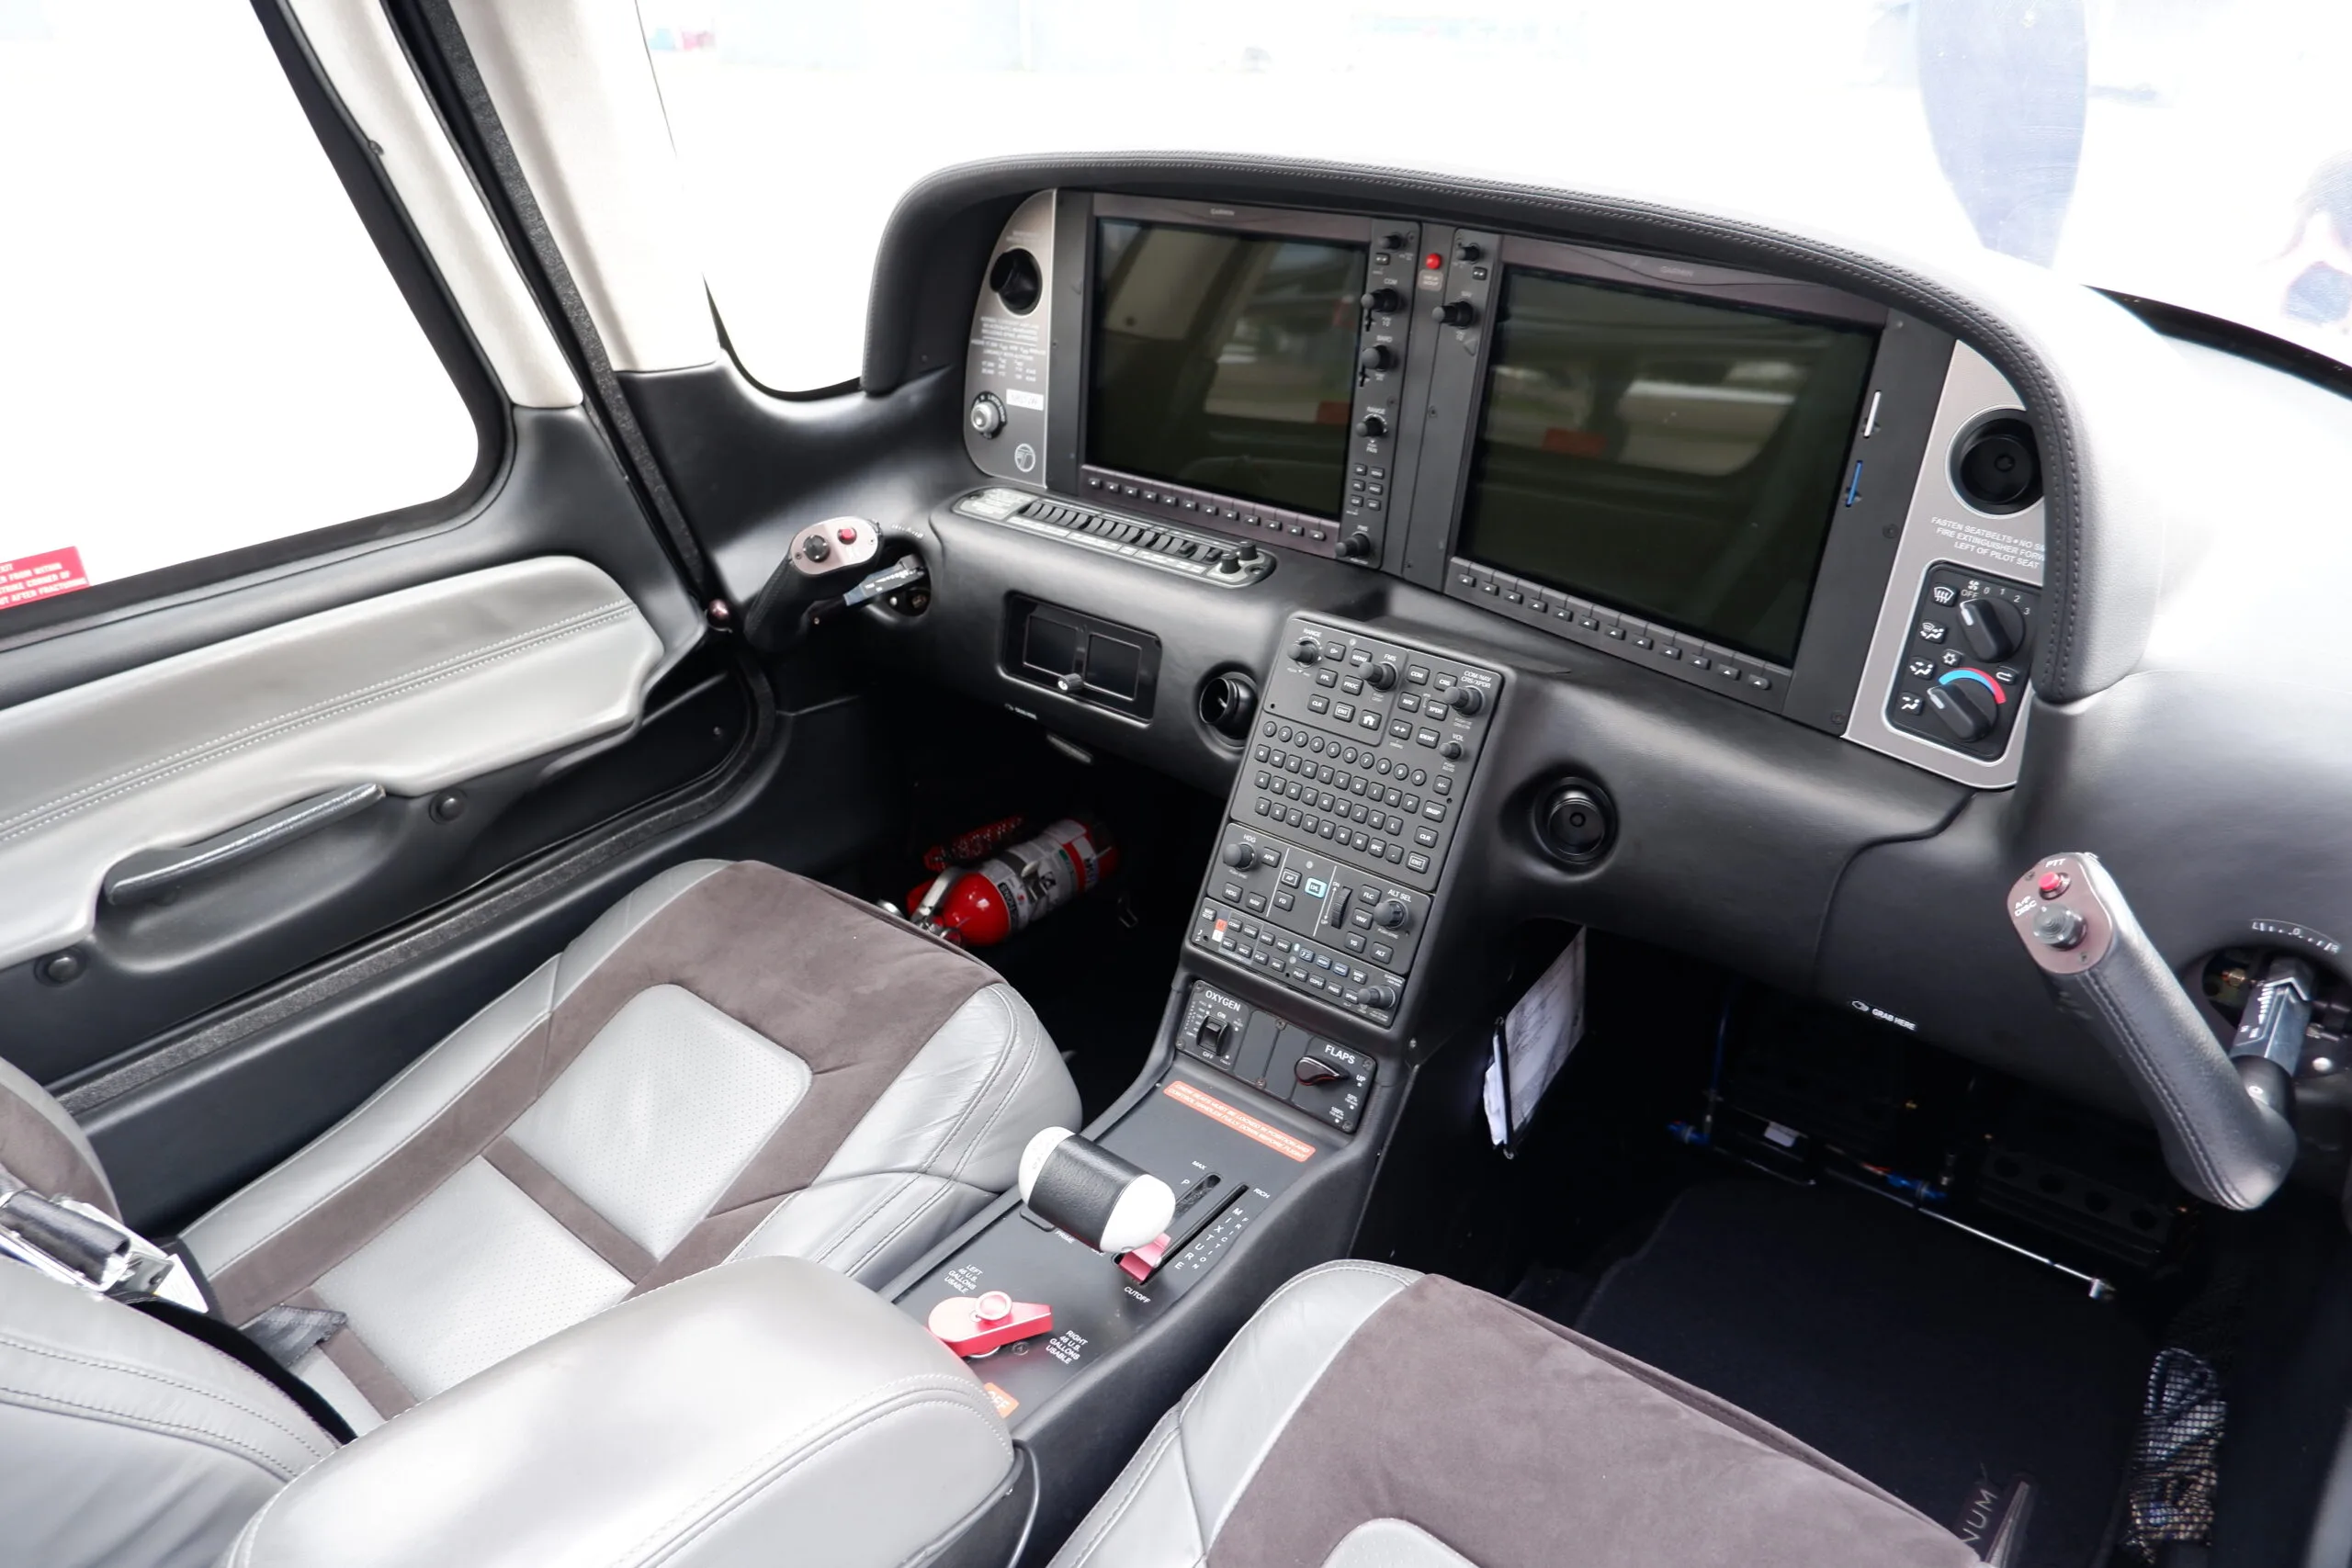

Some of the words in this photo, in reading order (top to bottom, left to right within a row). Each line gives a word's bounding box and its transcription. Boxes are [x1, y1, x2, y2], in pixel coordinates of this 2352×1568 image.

[1931, 516, 1964, 531] FASTEN
[1964, 525, 2013, 544] SEATBELTS
[2018, 539, 2032, 548] NO
[1937, 527, 1955, 538] FIRE
[1956, 533, 2018, 555] EXTINGUISHER
[1954, 542, 1975, 551] LEFT
[1990, 551, 2016, 562] PILOT
[2016, 558, 2040, 570] SEAT
[1961, 590, 1979, 599] OFF
[1303, 628, 1322, 637] RANGE
[1352, 654, 1367, 662] MENU
[1429, 706, 1442, 715] XPDR
[1419, 733, 1436, 741] IDENT
[1452, 733, 1464, 741] VOL
[1243, 834, 1256, 843] HDG
[1419, 833, 1431, 841] CLR
[1371, 843, 1382, 852] SPC
[1264, 853, 1275, 862] APR
[2045, 858, 2065, 867] PTT
[1399, 893, 1411, 902] SEL
[2015, 900, 2037, 917] DISC
[2252, 921, 2258, 930] L
[2331, 944, 2340, 953] R
[1205, 990, 1240, 1011] OXYGEN
[1872, 1009, 1894, 1021] GRAB
[1325, 1043, 1355, 1064] FLAPS
[1192, 1160, 1207, 1170] MAX
[1253, 1188, 1271, 1199] RICH
[1055, 1230, 1076, 1244] PRIME
[967, 1264, 983, 1276] LEFT
[948, 1269, 977, 1291] GALLONS
[966, 1272, 978, 1282] U.S.
[944, 1276, 968, 1293] USABLE
[1124, 1286, 1150, 1303] CUTOFF
[1066, 1330, 1088, 1346] RIGHT
[1049, 1337, 1080, 1359] GALLONS
[1068, 1340, 1080, 1352] U.S.
[1046, 1345, 1073, 1364] USABLE
